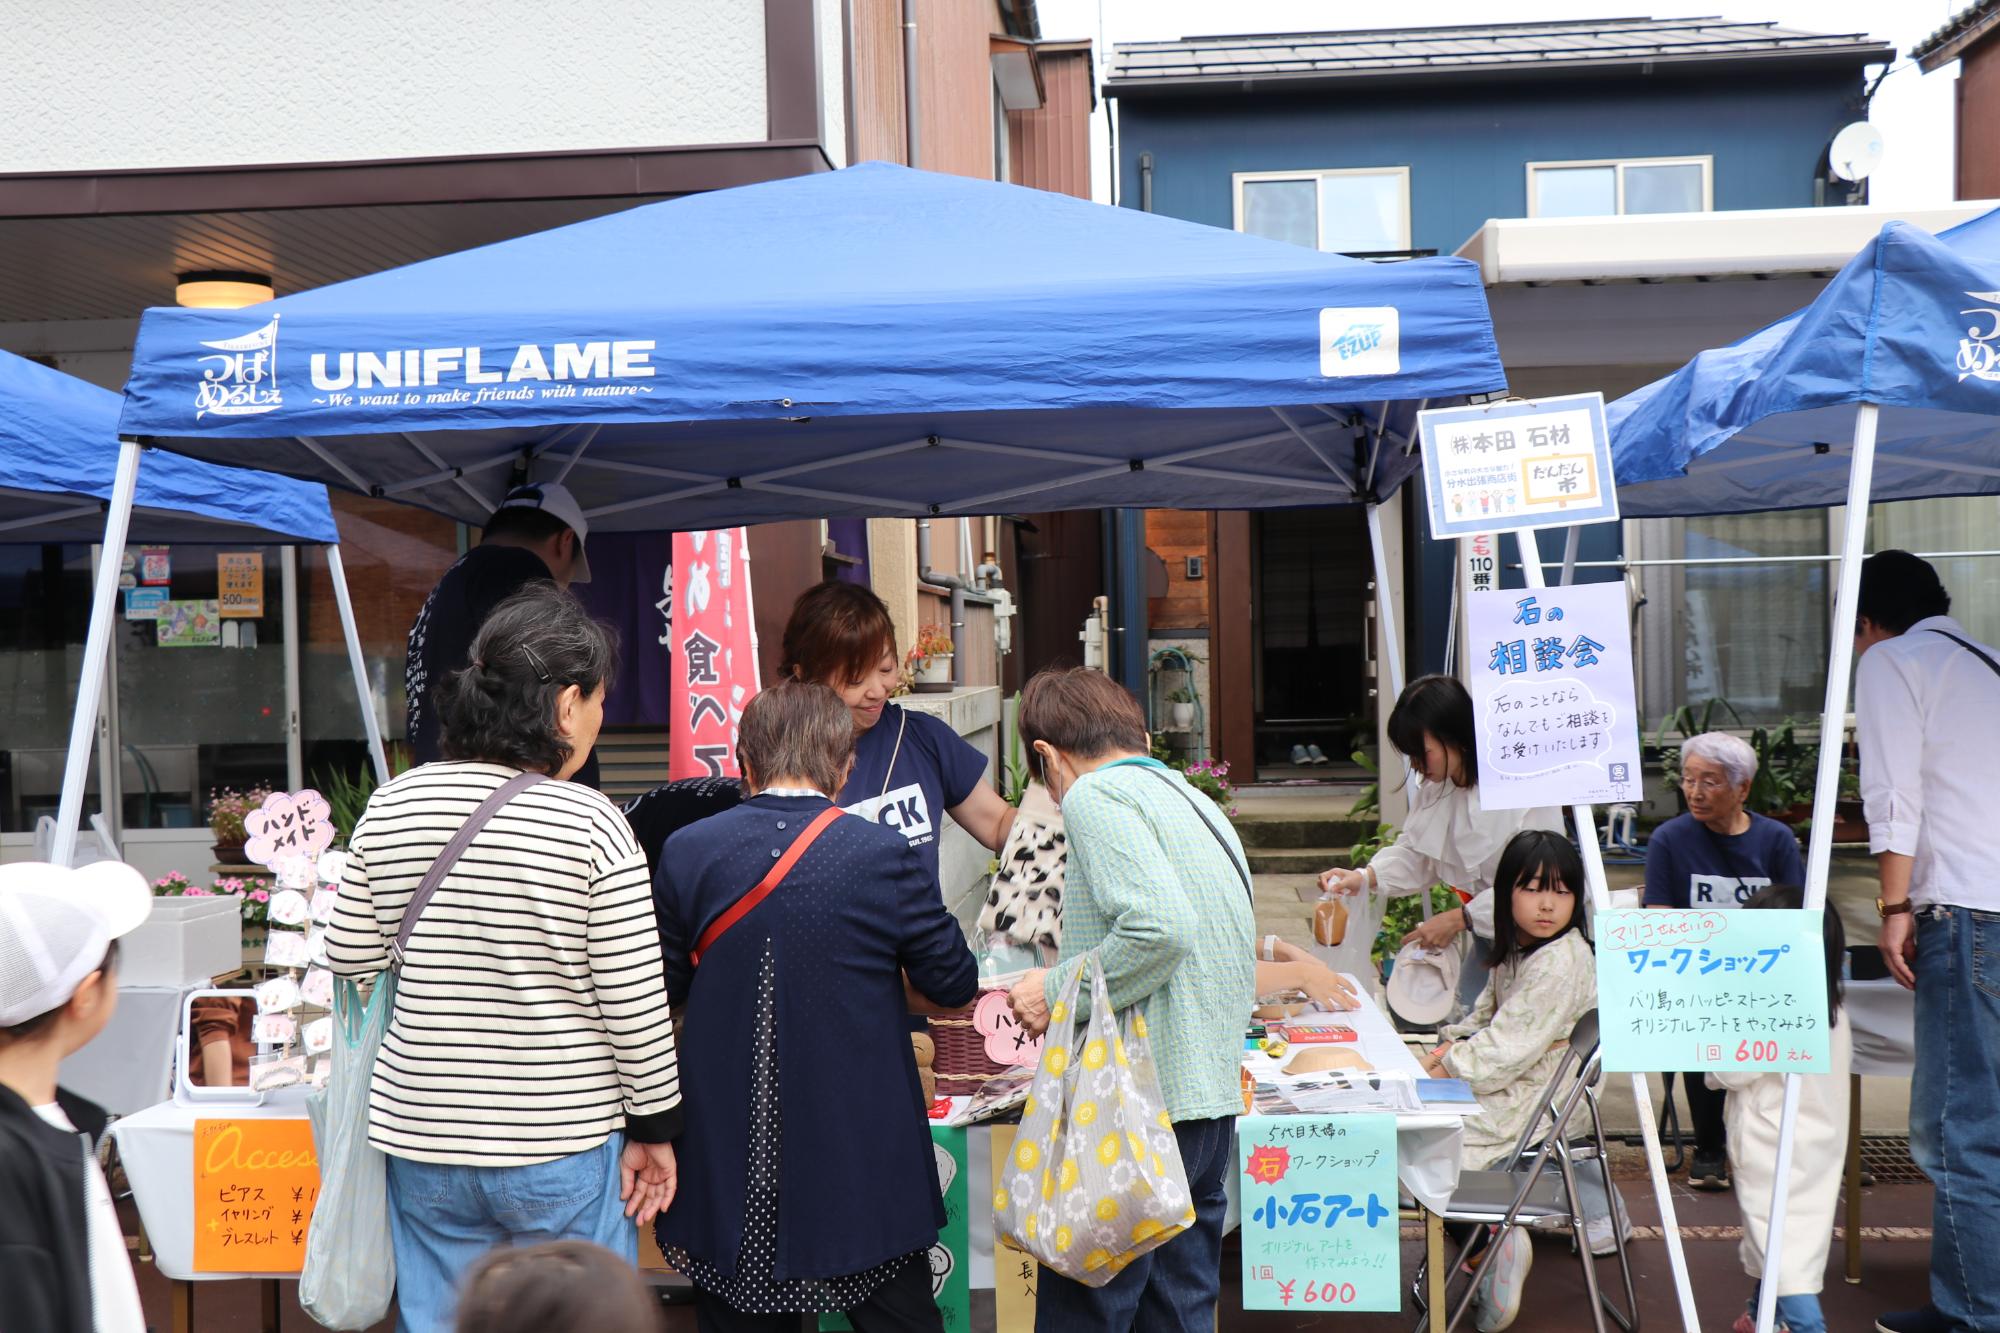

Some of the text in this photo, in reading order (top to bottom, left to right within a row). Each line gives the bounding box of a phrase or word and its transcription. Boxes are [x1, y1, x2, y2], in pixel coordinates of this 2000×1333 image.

[310, 340, 656, 391] UNIFLAME
[360, 393, 399, 405] want
[404, 392, 420, 404] to
[426, 389, 470, 404] make
[472, 386, 535, 403] friends
[542, 384, 576, 398] with
[1527, 424, 1571, 448] 石材
[1533, 462, 1584, 480] だんだん
[1557, 476, 1577, 495] 市
[223, 593, 242, 605] 500
[1513, 596, 1564, 626] 石の
[1488, 634, 1606, 675] 相談会
[1494, 687, 1579, 715] 石のことなら
[1498, 710, 1609, 738] なんでもご相談を
[1500, 731, 1601, 760] お受けいたします
[262, 800, 311, 835] ハンド
[273, 820, 316, 852] メイド
[1611, 919, 1714, 941] マリコせんせいの
[1627, 944, 1791, 975] ワークショップ
[1628, 989, 1797, 1011] バリ島のハッピーストーンで
[1631, 1015, 1816, 1035] オリジナルアートをやってみよう
[1735, 1039, 1778, 1062] 600
[1786, 1047, 1813, 1061] えん
[1268, 1123, 1346, 1141] 5代目夫婦の
[1258, 1150, 1379, 1178] 石 ワークショップ
[219, 1184, 266, 1203] ピアス
[221, 1206, 275, 1222] イヤリング
[1252, 1193, 1390, 1229] 小石アート
[222, 1227, 279, 1247] ブレスレット
[1252, 1265, 1274, 1280] 1回
[1276, 1279, 1356, 1306] ¥600
